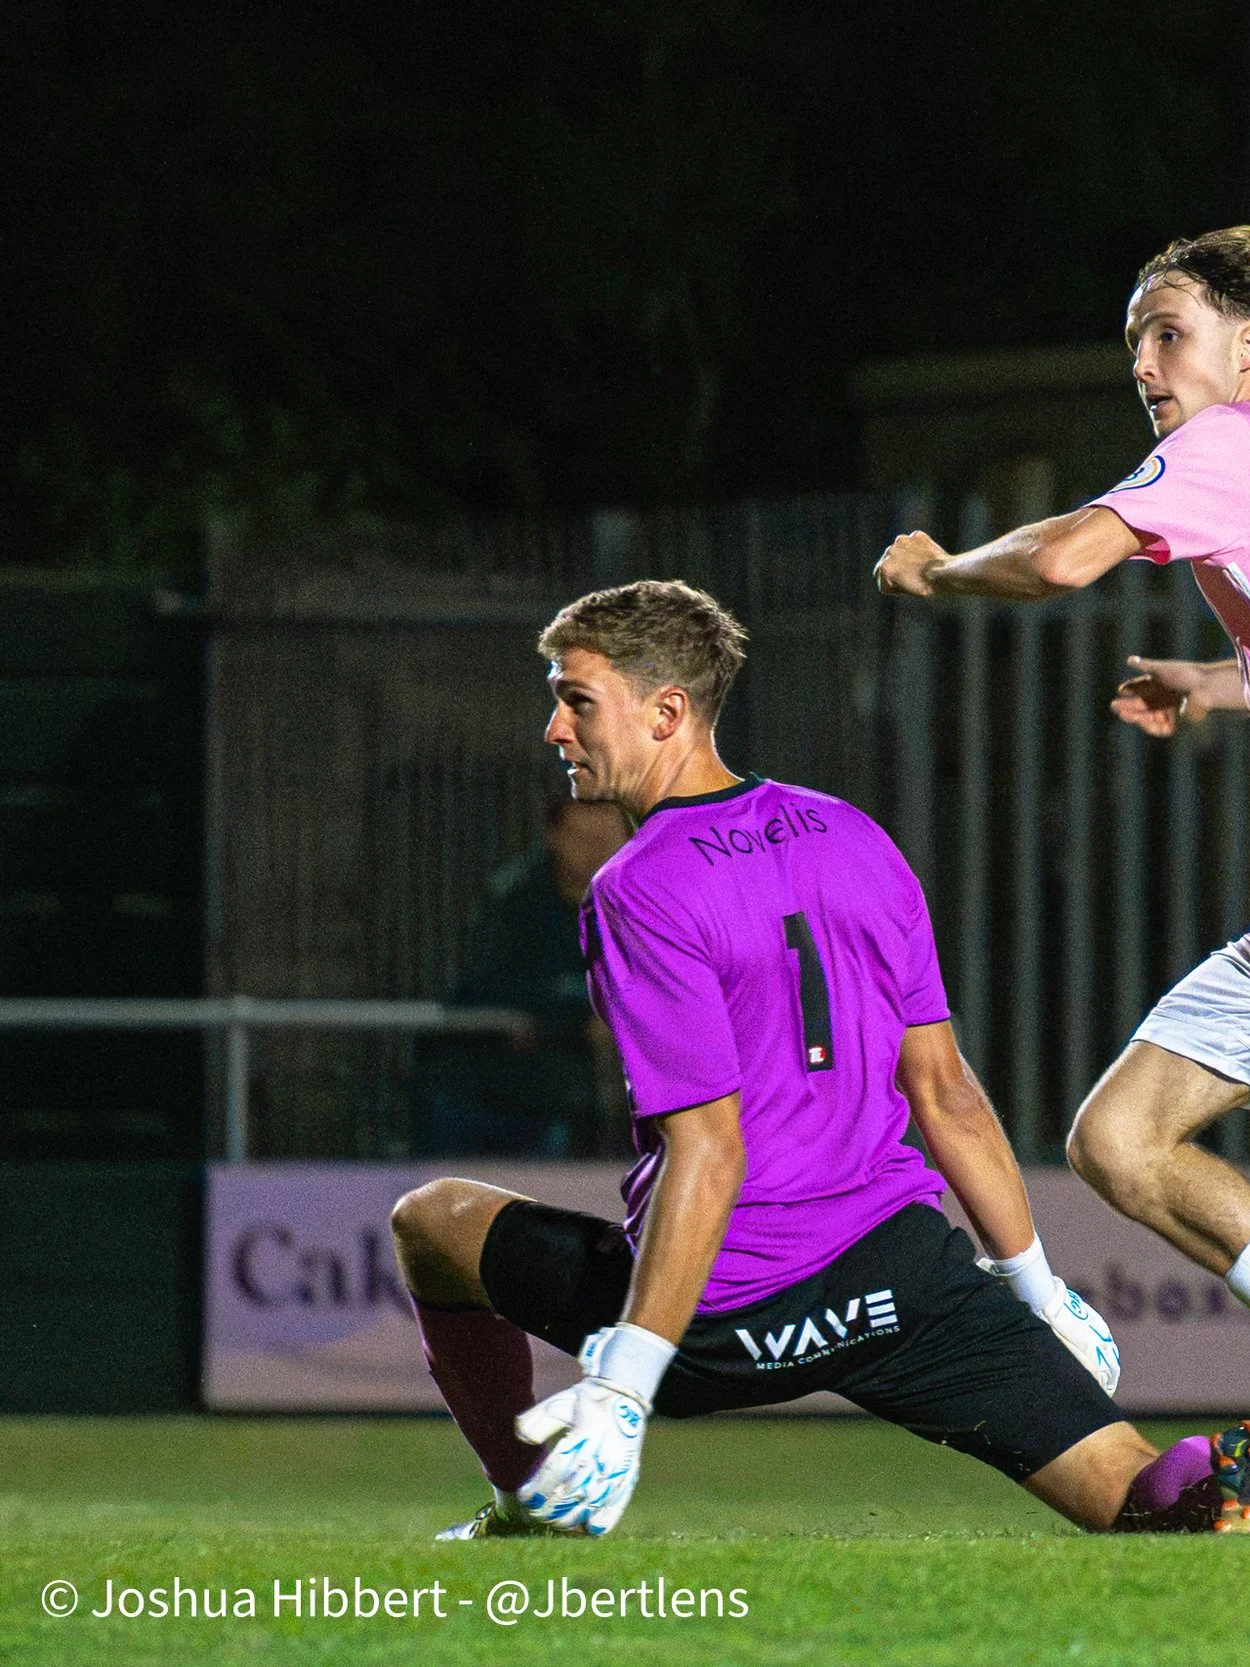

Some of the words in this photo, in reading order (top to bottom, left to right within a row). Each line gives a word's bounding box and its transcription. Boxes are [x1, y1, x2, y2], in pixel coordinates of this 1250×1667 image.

[688, 803, 829, 867] Novelis
[782, 911, 836, 1073] 1
[734, 1289, 898, 1361] WAVE
[756, 1360, 796, 1371] MEDIA
[797, 1325, 901, 1365] COMMUNICATIONS
